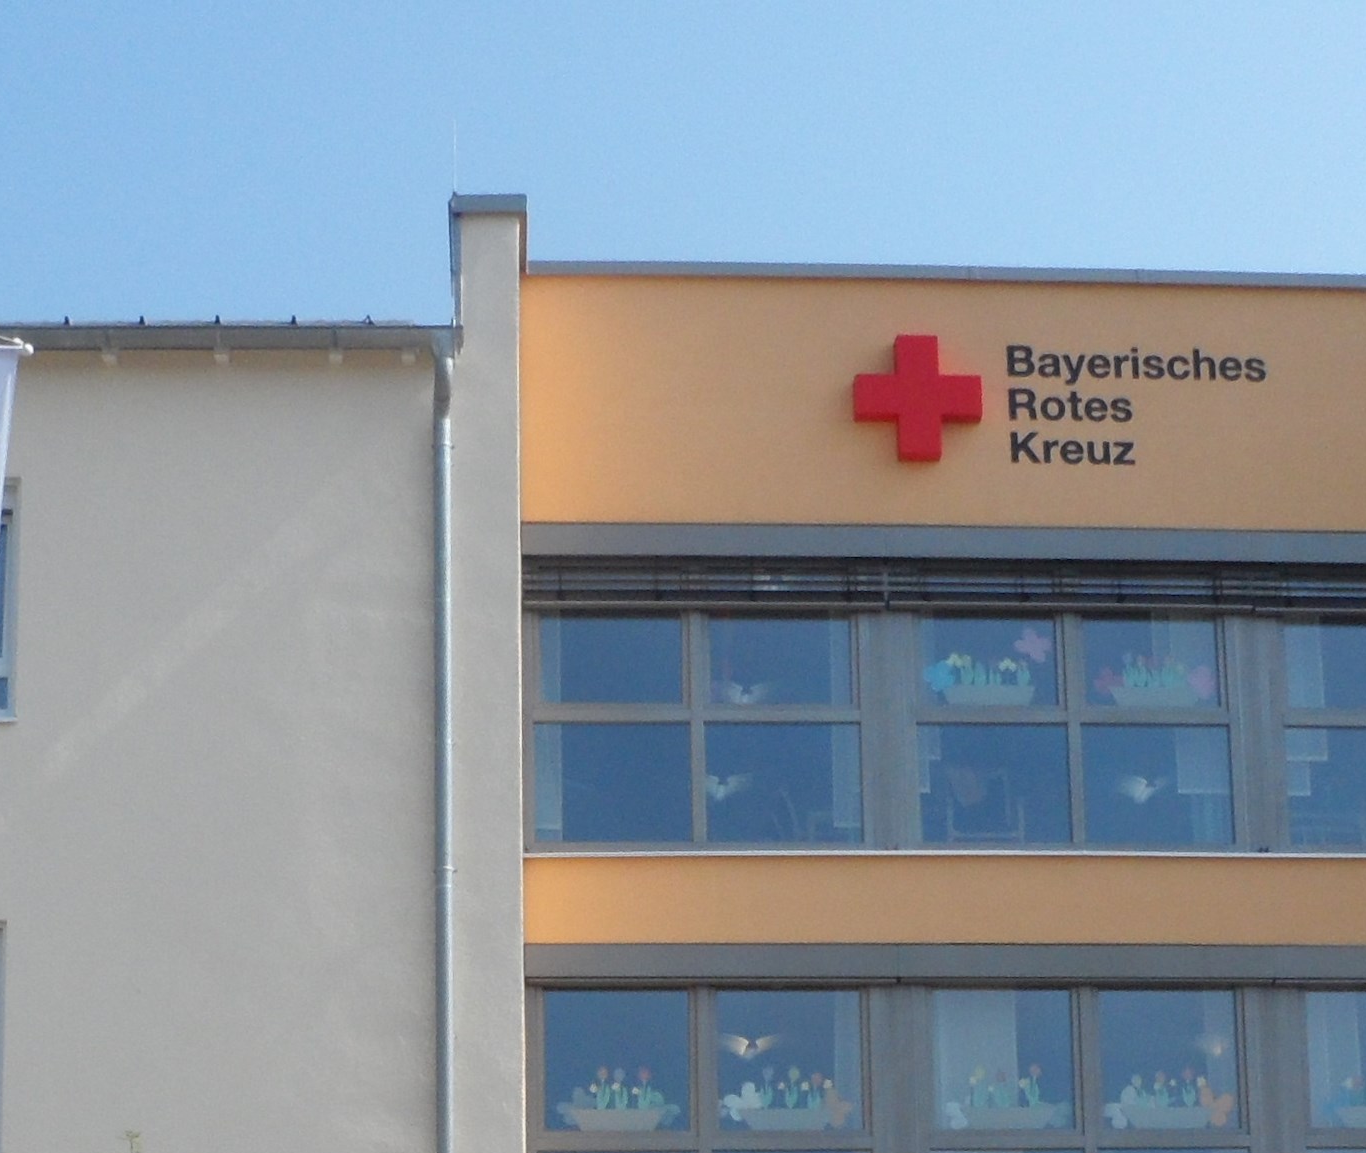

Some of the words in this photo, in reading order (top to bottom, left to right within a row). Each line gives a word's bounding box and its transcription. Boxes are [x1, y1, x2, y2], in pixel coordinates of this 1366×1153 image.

[1006, 344, 1267, 386] Bayerisches
[1008, 387, 1133, 423] Rotes
[1011, 431, 1136, 466] Kreuz
